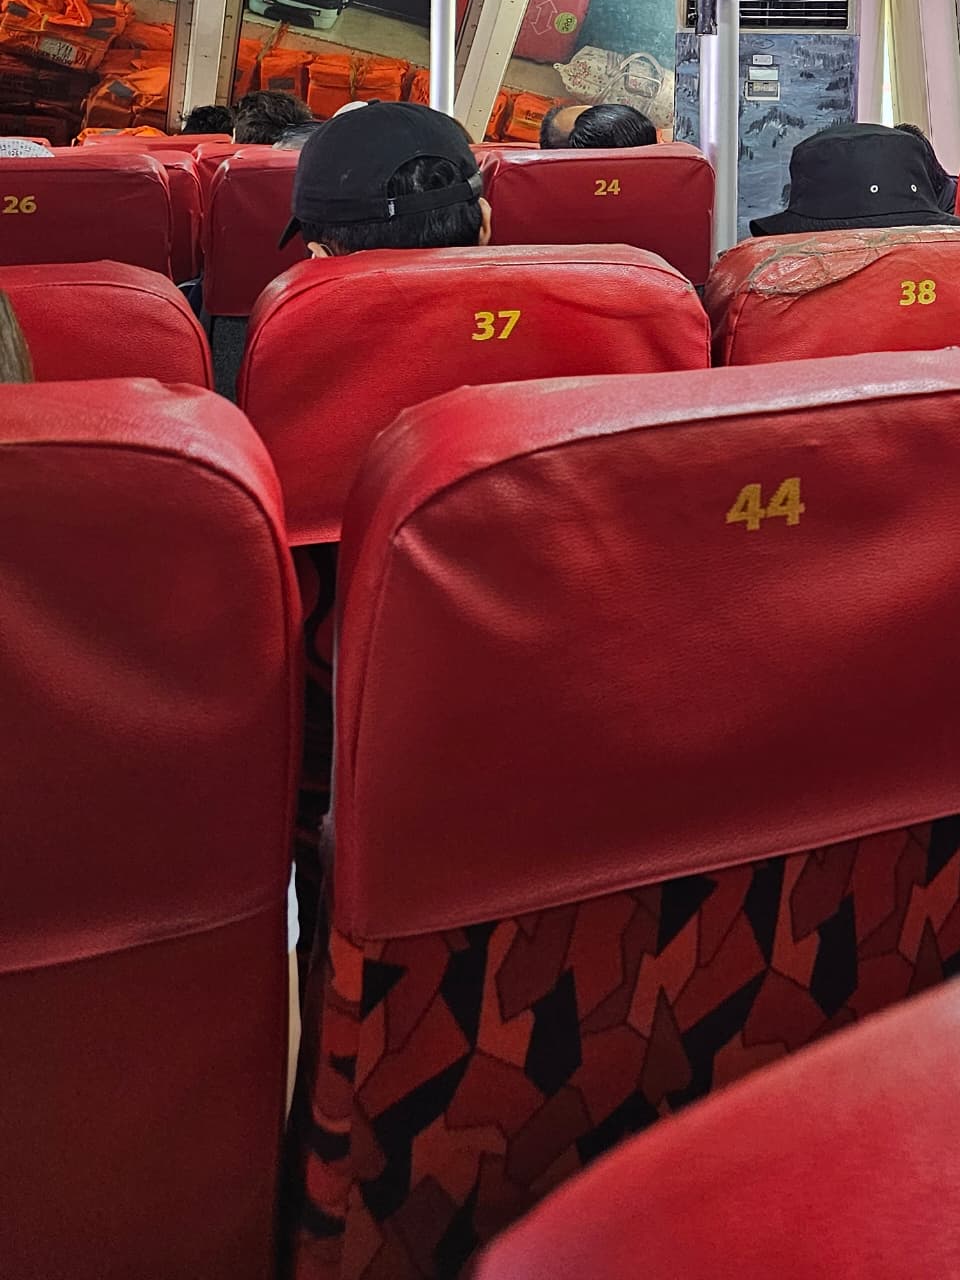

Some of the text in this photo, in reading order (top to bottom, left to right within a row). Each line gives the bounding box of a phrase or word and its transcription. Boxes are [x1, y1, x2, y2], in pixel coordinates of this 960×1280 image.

[594, 179, 621, 196] 24
[2, 195, 37, 214] 26
[899, 279, 936, 306] 38
[471, 310, 521, 341] 37
[725, 477, 806, 531] 44
